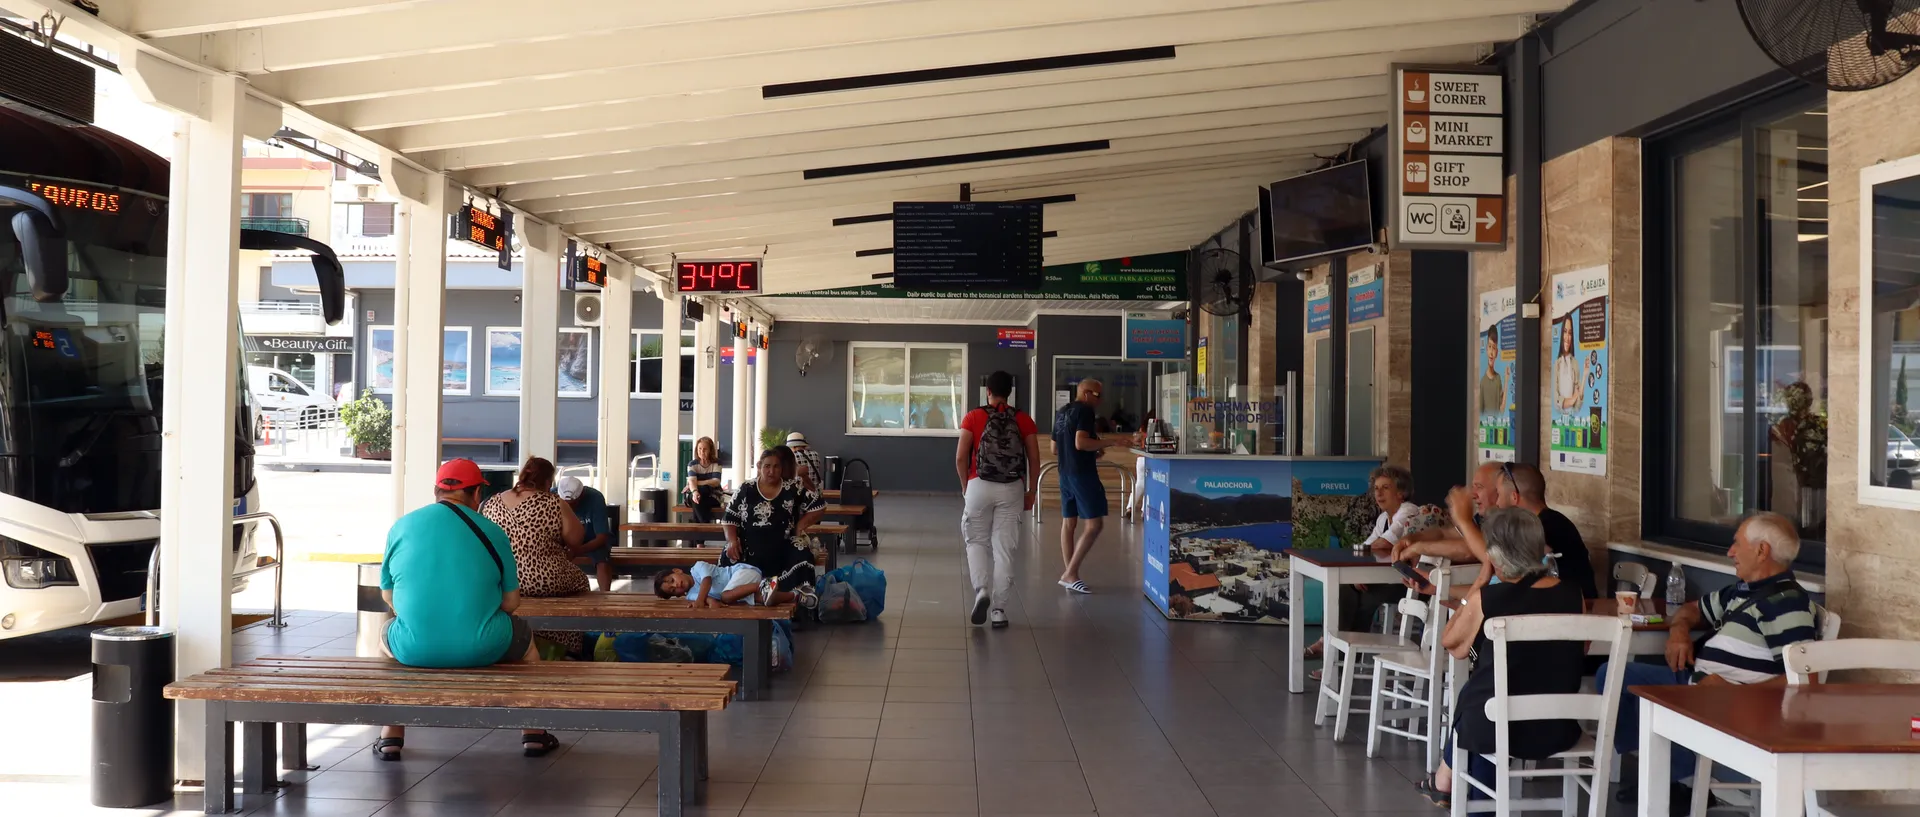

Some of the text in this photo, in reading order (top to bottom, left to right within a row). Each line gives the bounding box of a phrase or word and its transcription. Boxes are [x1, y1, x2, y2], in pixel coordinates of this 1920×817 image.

[1434, 81, 1479, 93] SWEET
[1434, 94, 1487, 106] CORNER
[1434, 121, 1469, 133] MINI
[1434, 134, 1493, 147] MARKET
[1434, 162, 1465, 173] GIFT
[1433, 175, 1470, 187] SHOP
[1410, 211, 1434, 225] WC
[567, 257, 574, 288] 4
[1154, 284, 1177, 292] Crete
[1586, 278, 1606, 290] ΔΕΔΙΣΑ
[272, 338, 318, 351] Beauty
[325, 339, 348, 350] Gift
[1193, 401, 1280, 412] INFORMATION
[1204, 481, 1253, 490] PALAIOCHORA
[1320, 482, 1350, 490] PREVELI
